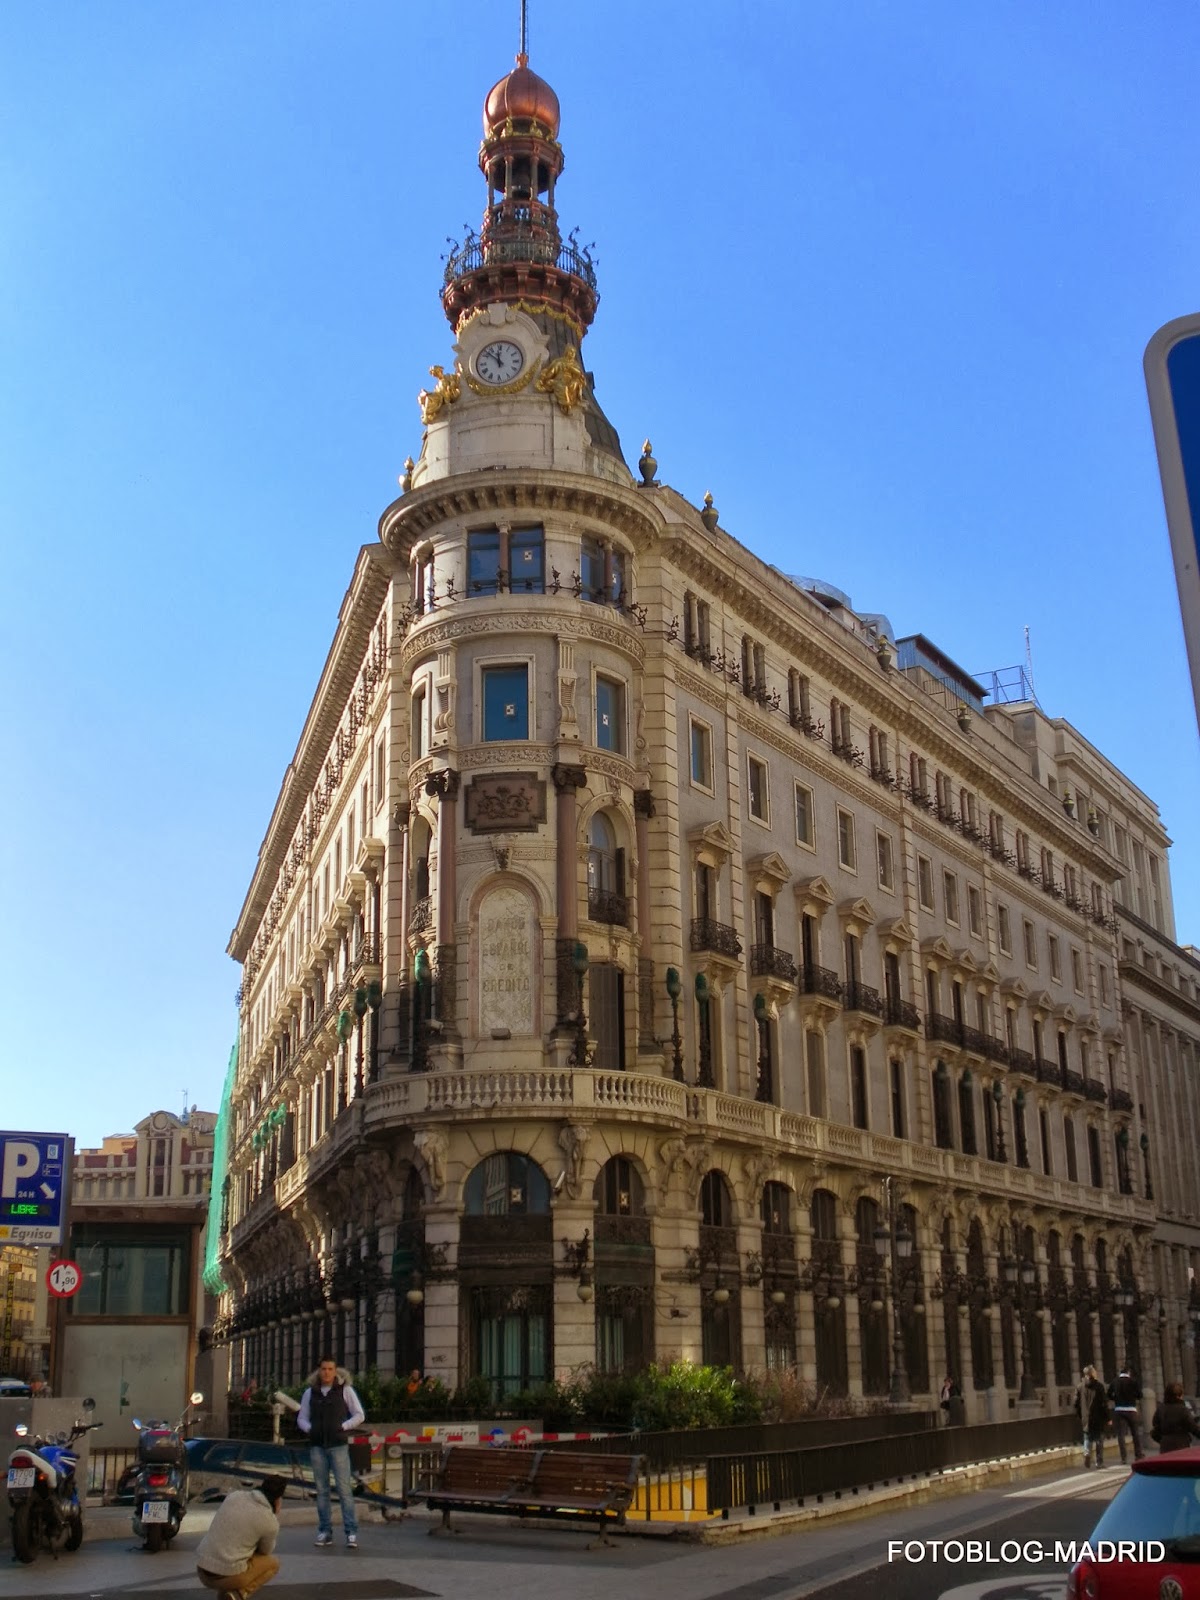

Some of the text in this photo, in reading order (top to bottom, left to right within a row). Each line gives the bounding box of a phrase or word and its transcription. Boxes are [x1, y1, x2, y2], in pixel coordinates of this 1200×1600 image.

[1, 1142, 40, 1198] P
[10, 1204, 39, 1215] LIBRE
[11, 1227, 53, 1241] Eguisa
[53, 1269, 76, 1287] 1,90
